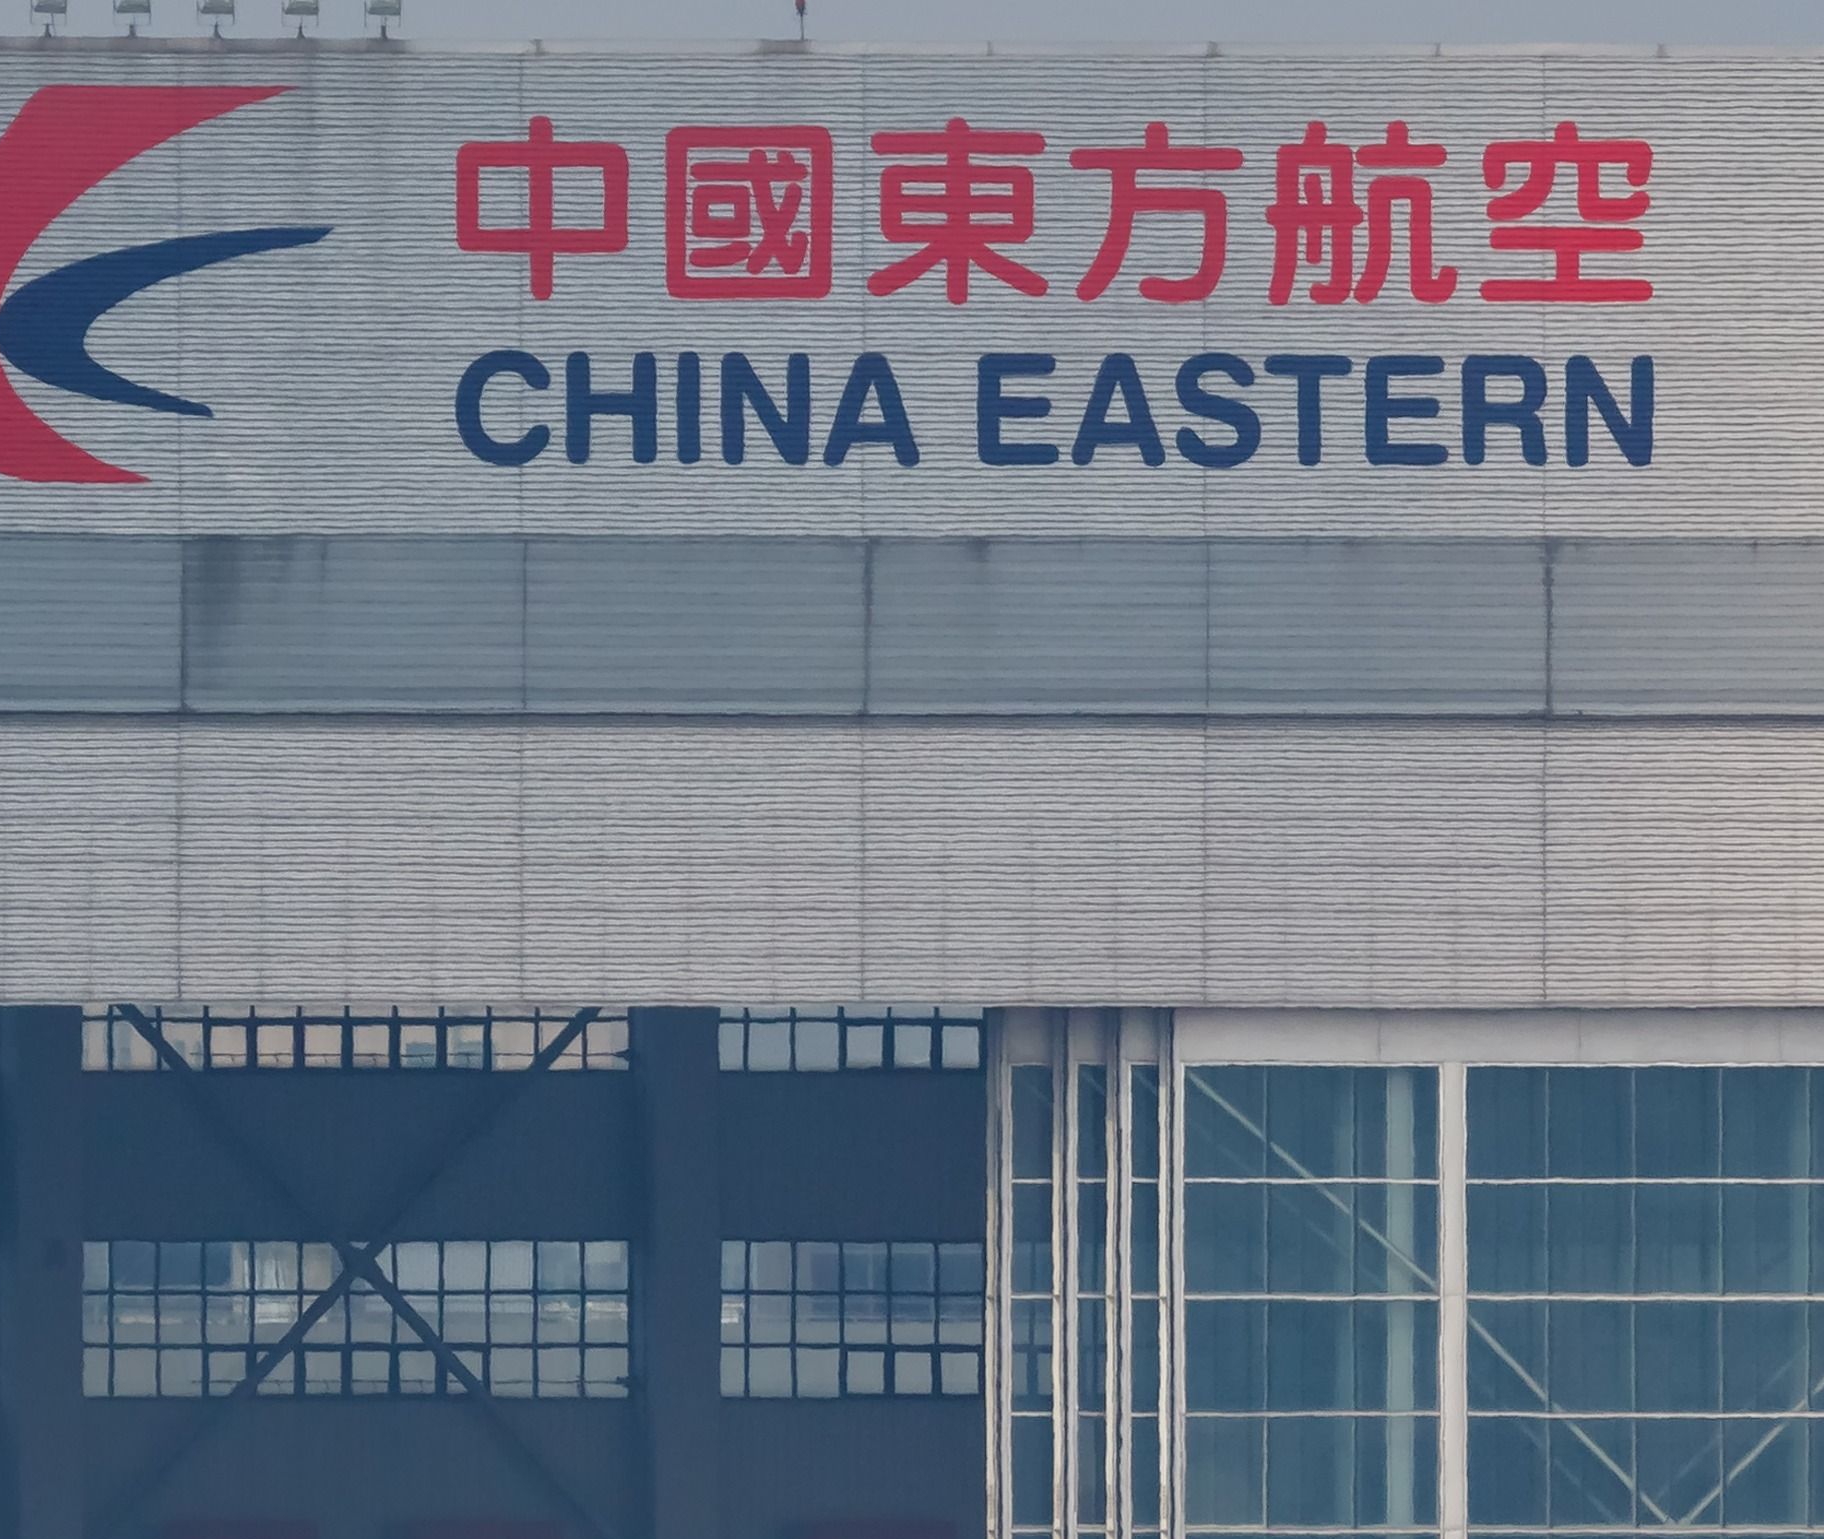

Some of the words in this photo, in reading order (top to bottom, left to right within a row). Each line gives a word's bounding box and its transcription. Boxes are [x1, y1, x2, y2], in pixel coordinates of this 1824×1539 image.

[453, 115, 1655, 303] 中國東方航空
[453, 348, 919, 470] CHINA
[975, 350, 1656, 470] EASTERN
